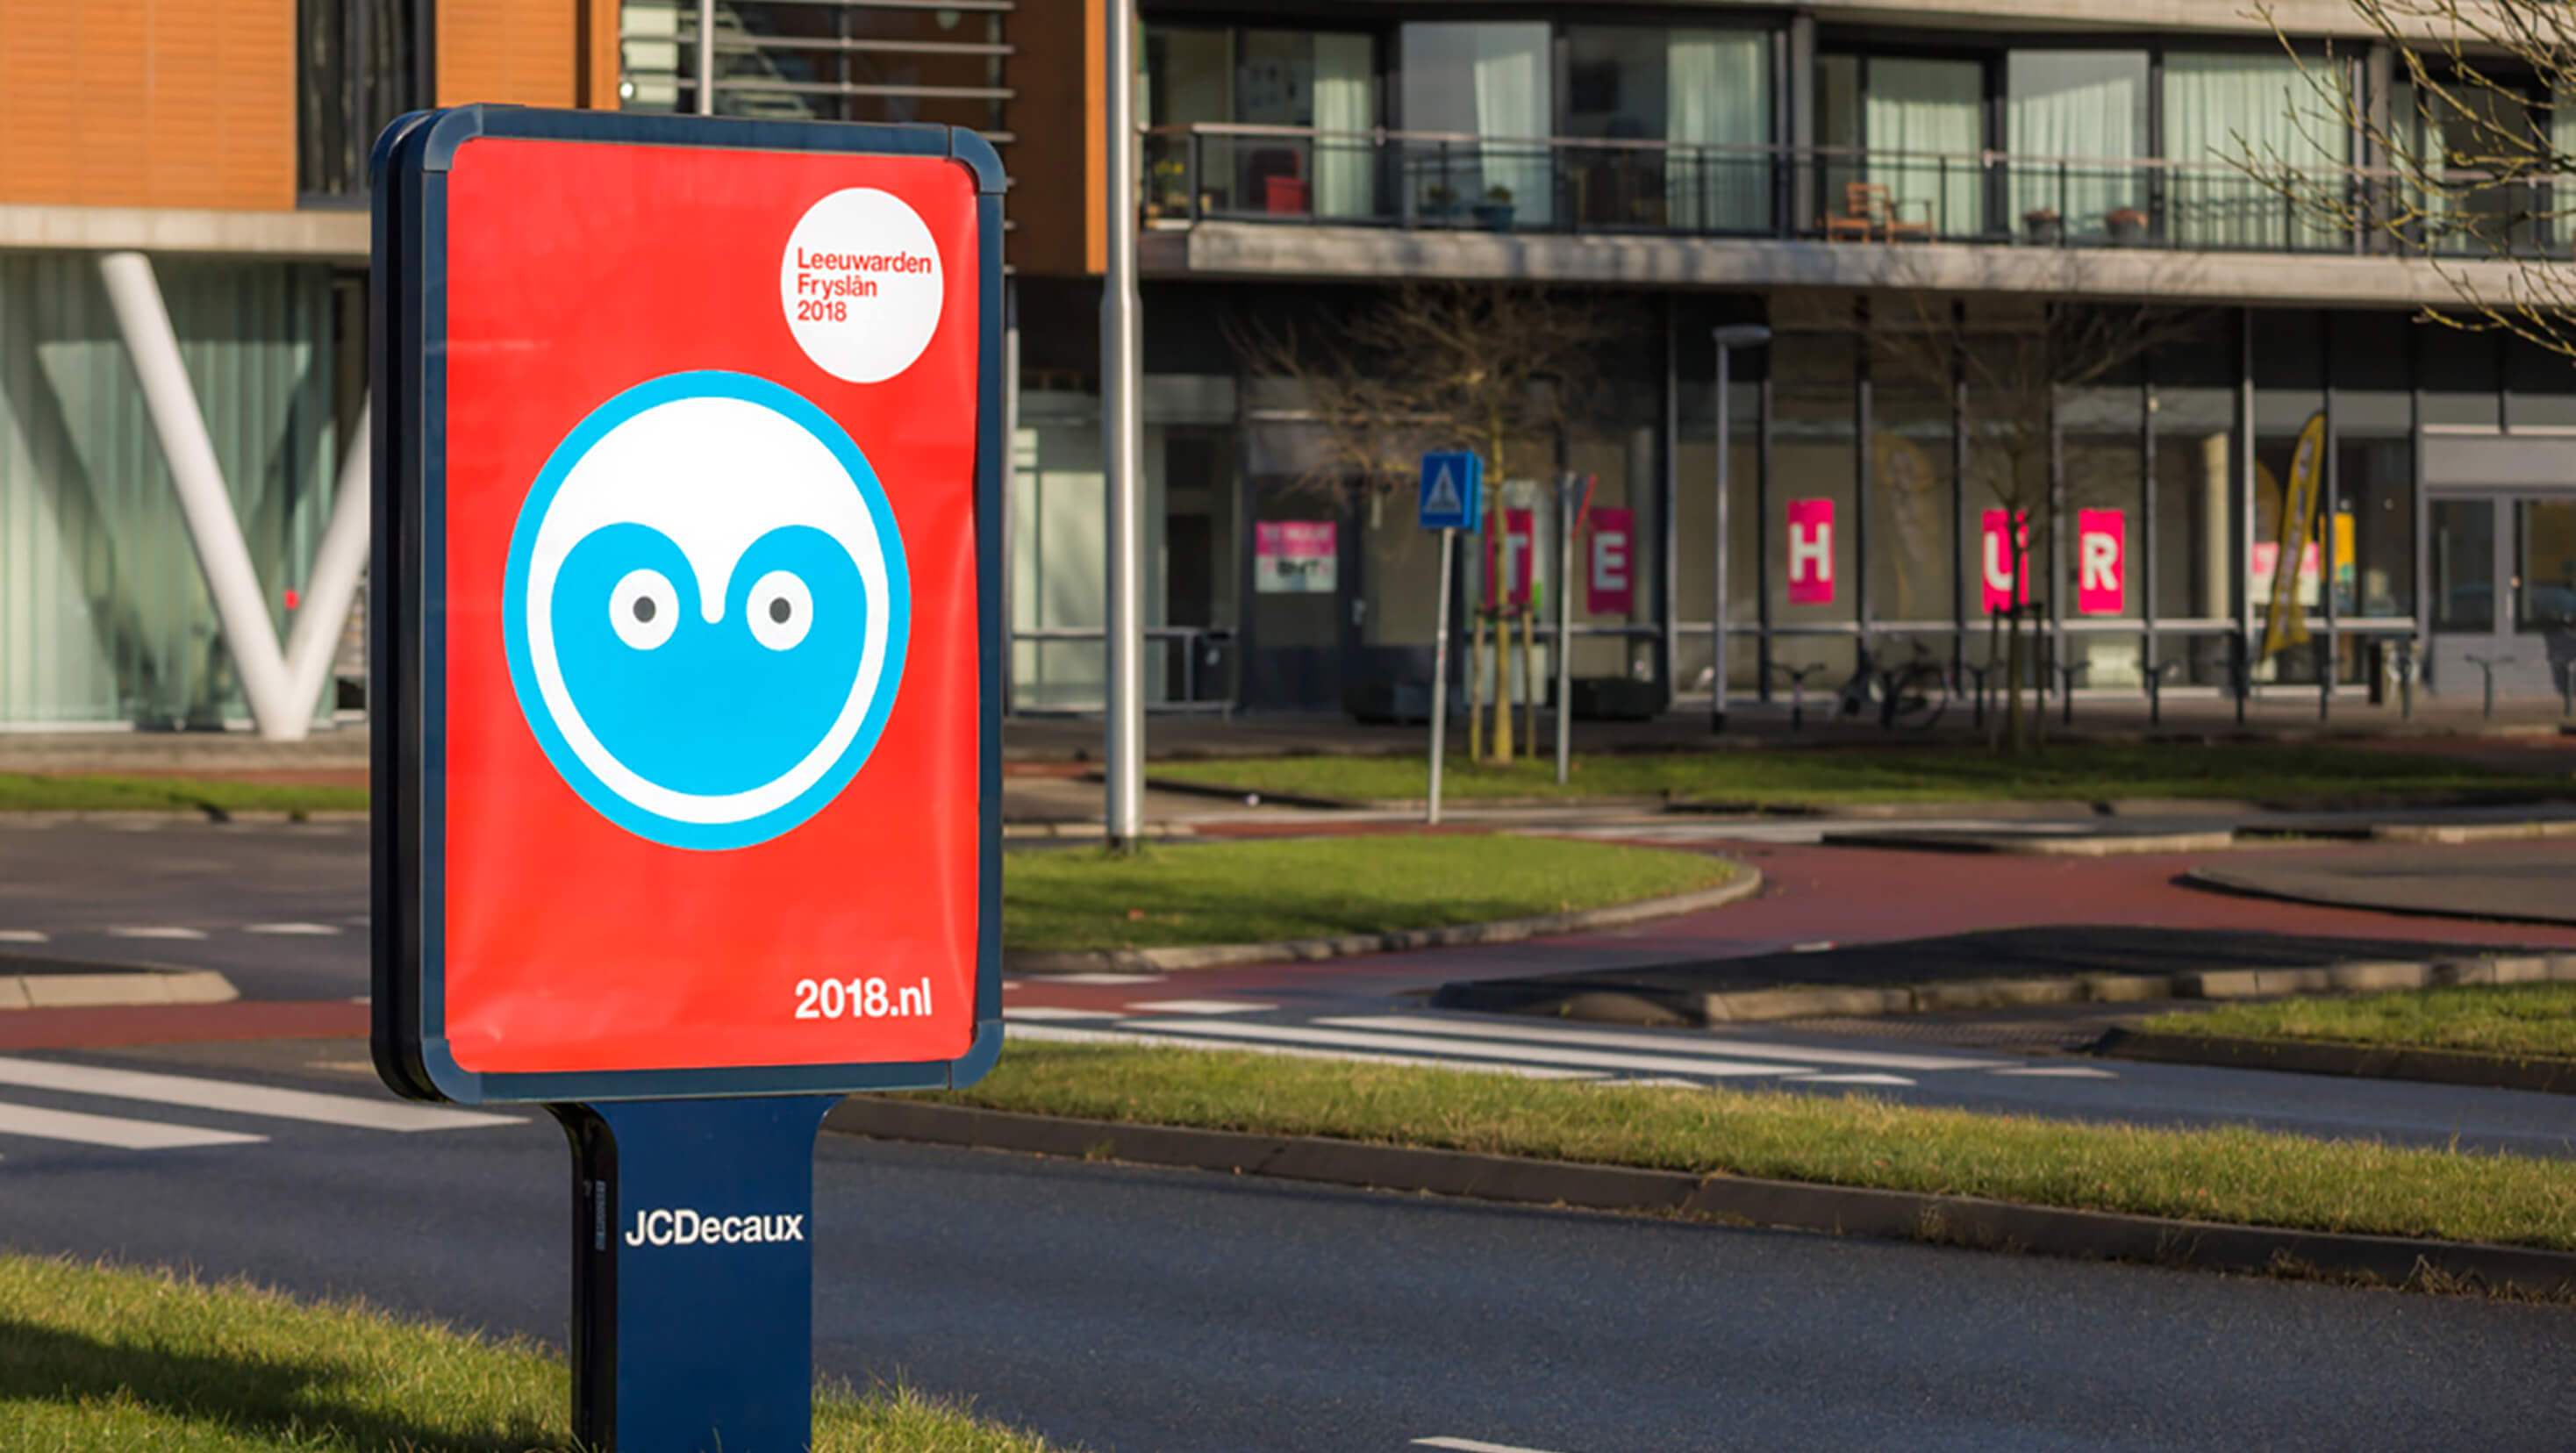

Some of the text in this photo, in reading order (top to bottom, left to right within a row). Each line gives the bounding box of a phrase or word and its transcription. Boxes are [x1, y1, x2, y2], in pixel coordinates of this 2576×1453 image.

[797, 247, 932, 275] Leeuwarden
[797, 273, 878, 300] Fryslân
[797, 299, 848, 323] 2018
[794, 977, 933, 1019] 2018.nl
[624, 1208, 805, 1247] JCDecaux
